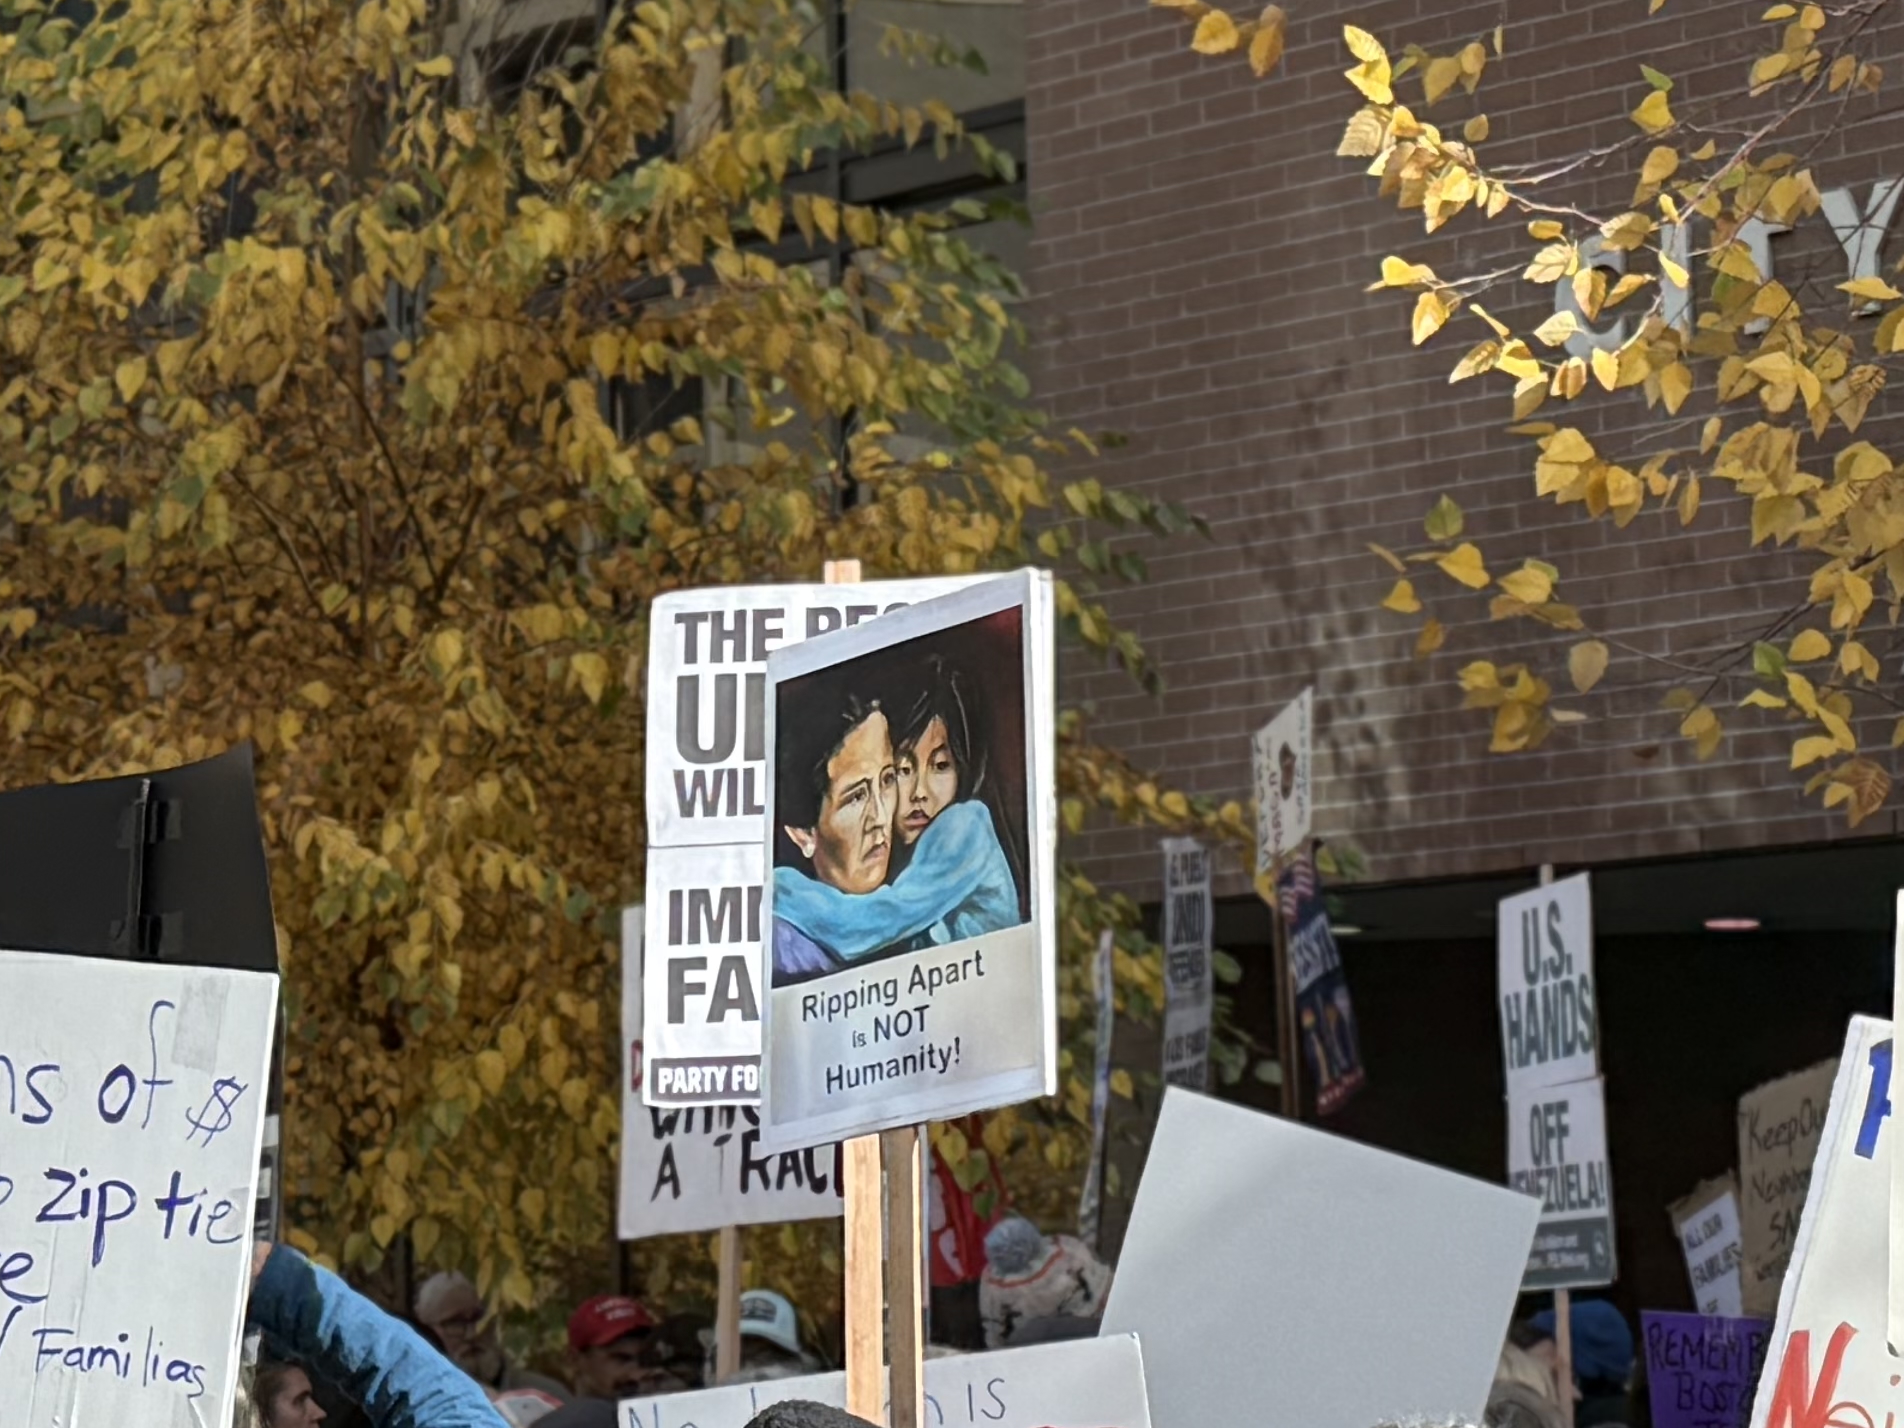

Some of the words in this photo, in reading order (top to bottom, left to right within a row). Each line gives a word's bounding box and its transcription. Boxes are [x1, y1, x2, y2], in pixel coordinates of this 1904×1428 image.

[674, 609, 785, 665] THE
[1521, 899, 1573, 986] U.S.
[802, 973, 899, 1023] Ripping
[907, 949, 985, 995] Apart
[873, 1004, 930, 1043] NOT
[1504, 973, 1594, 1070] HANDS
[98, 1001, 173, 1129] of
[186, 1076, 248, 1147] $
[658, 1065, 728, 1094] PARTY
[731, 1064, 761, 1092] FO
[825, 1036, 963, 1095] Humanity!
[1529, 1100, 1570, 1167] OFF
[36, 1167, 136, 1267] zip
[155, 1170, 243, 1245] tie
[1647, 1321, 1765, 1373] REMEMB
